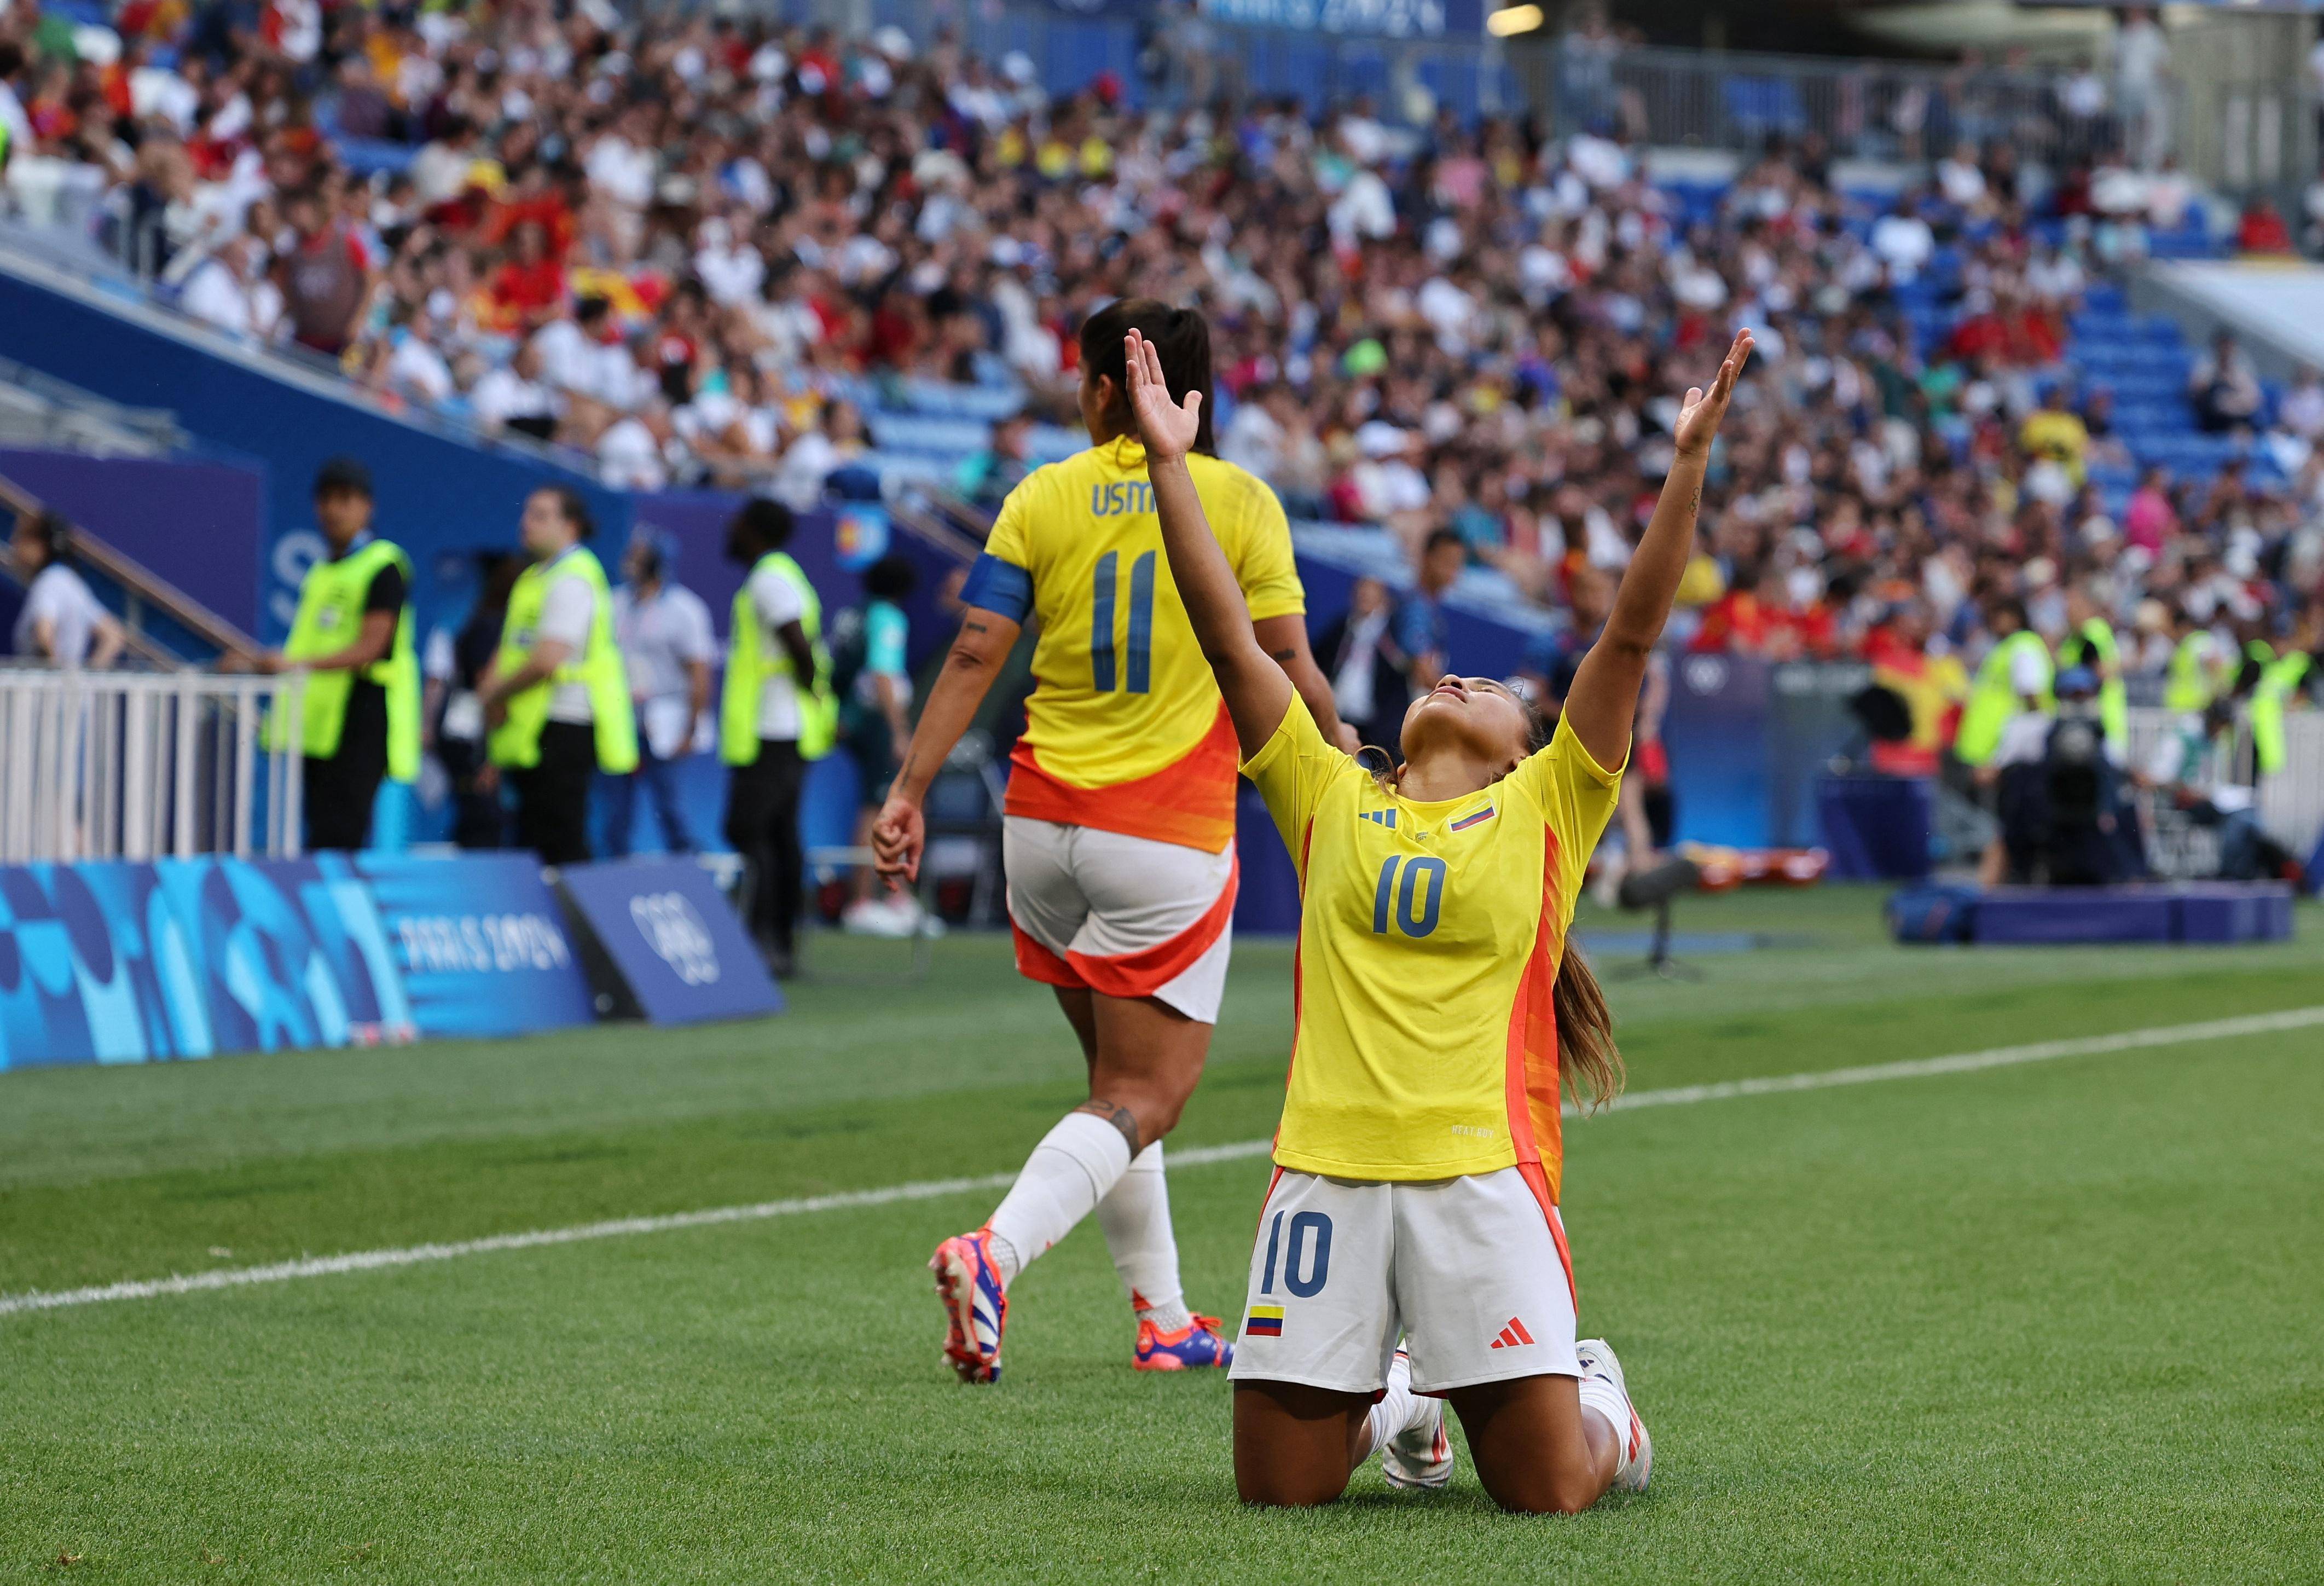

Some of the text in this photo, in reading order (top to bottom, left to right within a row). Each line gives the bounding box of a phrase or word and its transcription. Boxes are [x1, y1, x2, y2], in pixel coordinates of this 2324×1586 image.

[1092, 480, 1156, 516] USM
[1091, 550, 1156, 693] 11
[1372, 854, 1446, 938] 10
[1260, 1210, 1333, 1298] 10
